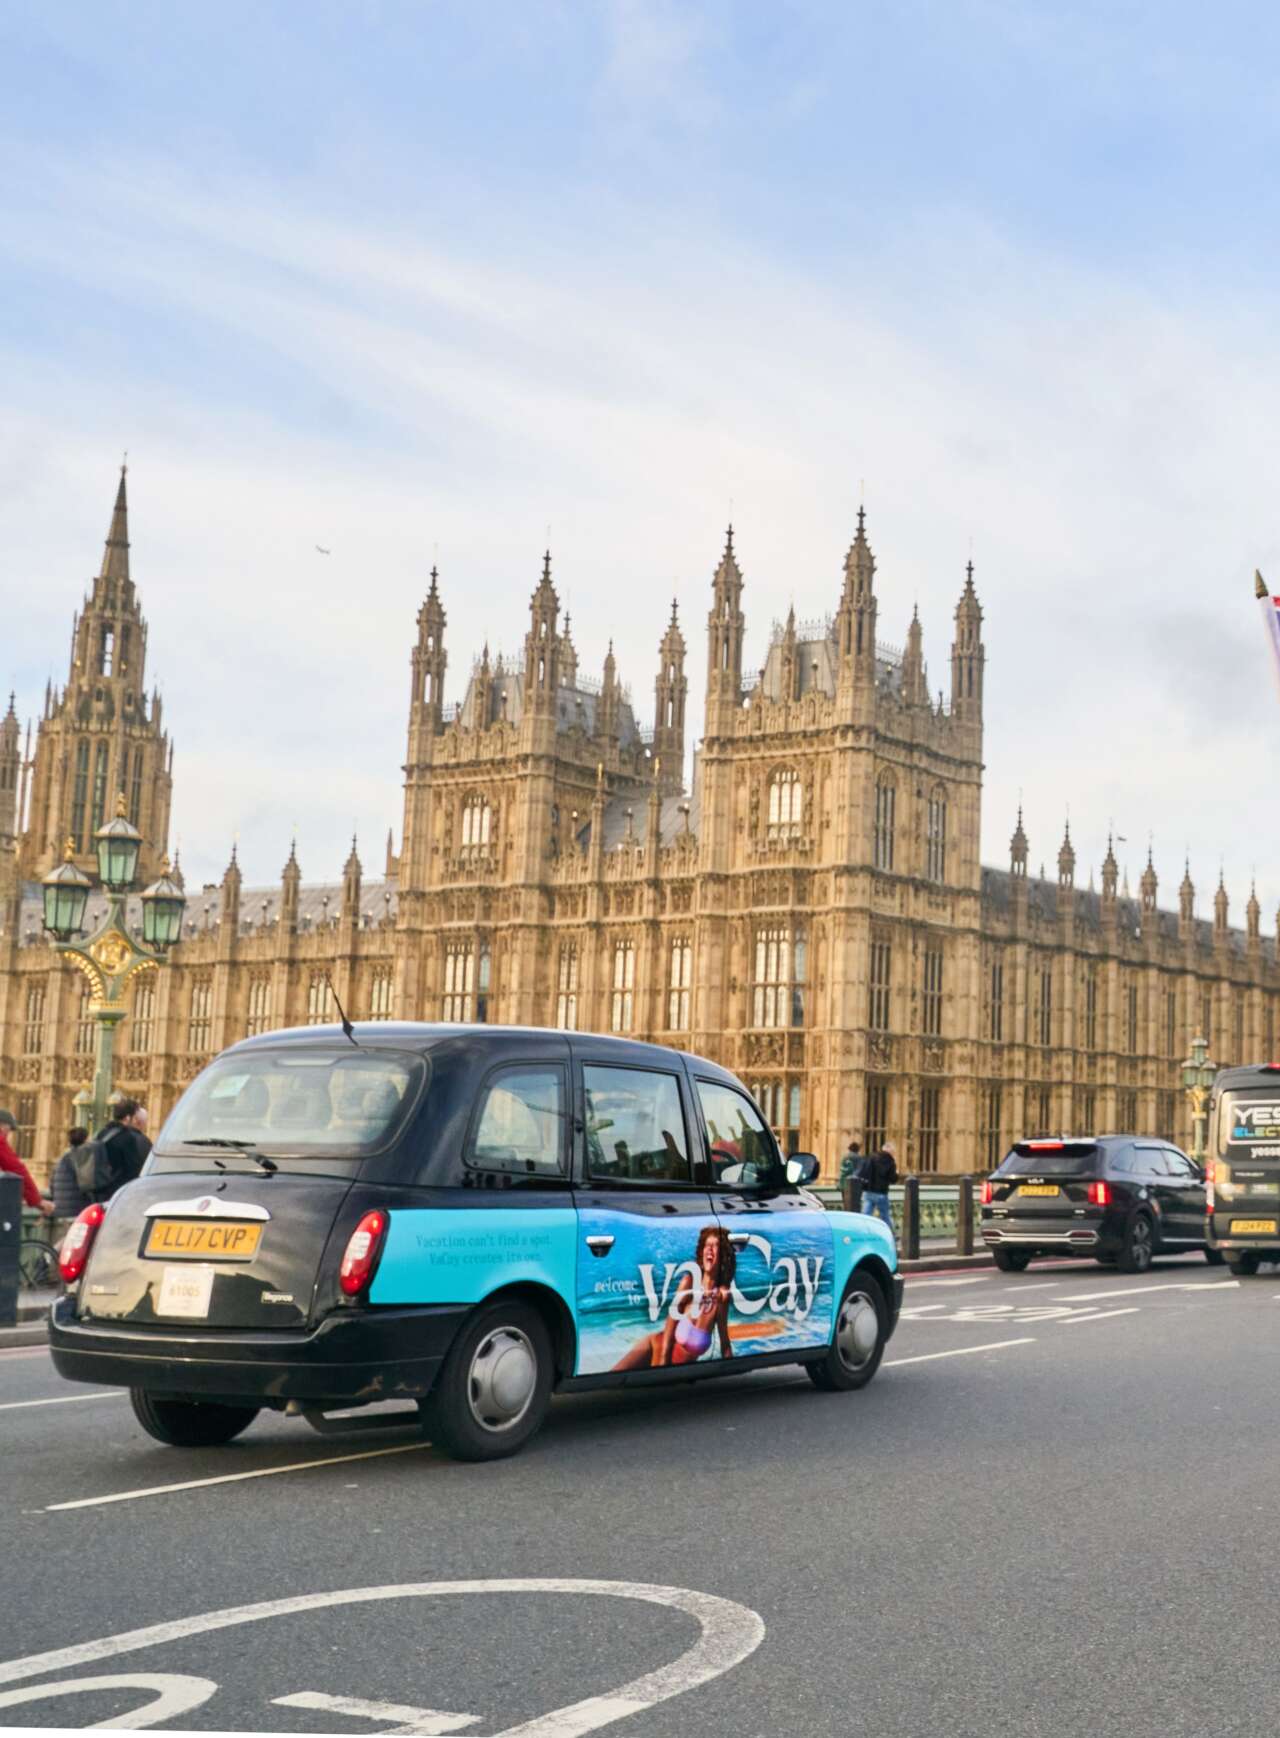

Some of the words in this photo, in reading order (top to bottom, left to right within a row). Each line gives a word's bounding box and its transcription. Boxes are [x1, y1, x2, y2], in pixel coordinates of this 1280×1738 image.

[163, 1226, 206, 1246] LL17
[208, 1227, 248, 1249] CVP
[594, 1278, 638, 1293] welcome
[628, 1293, 641, 1306] to
